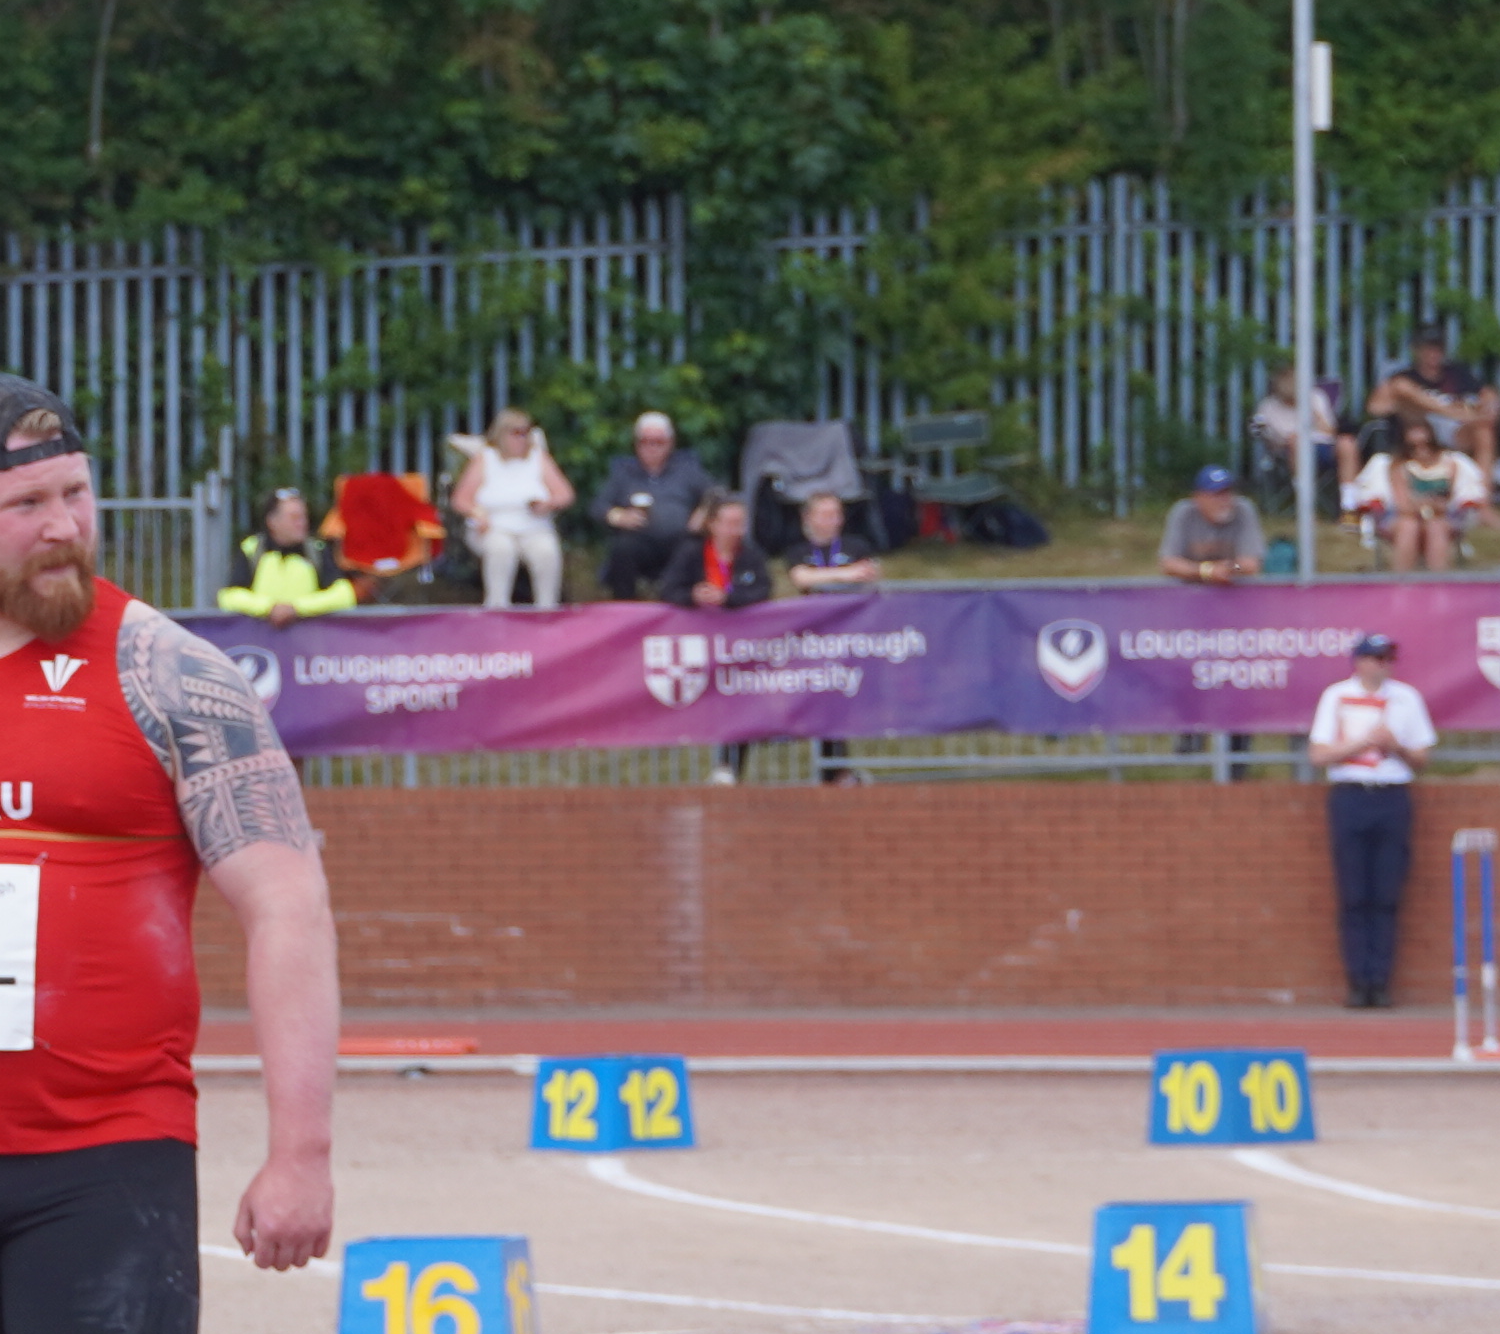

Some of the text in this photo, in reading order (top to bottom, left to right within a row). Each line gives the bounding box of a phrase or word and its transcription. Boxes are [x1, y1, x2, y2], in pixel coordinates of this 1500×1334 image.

[714, 626, 926, 665] Loughborough
[294, 652, 533, 685] LOUGHBOROUGH
[715, 664, 863, 698] University
[1193, 659, 1291, 689] SPORT
[365, 683, 462, 714] SPORT
[542, 1067, 682, 1141] 12 12
[1159, 1059, 1302, 1135] 10 10
[1110, 1222, 1226, 1323] 14
